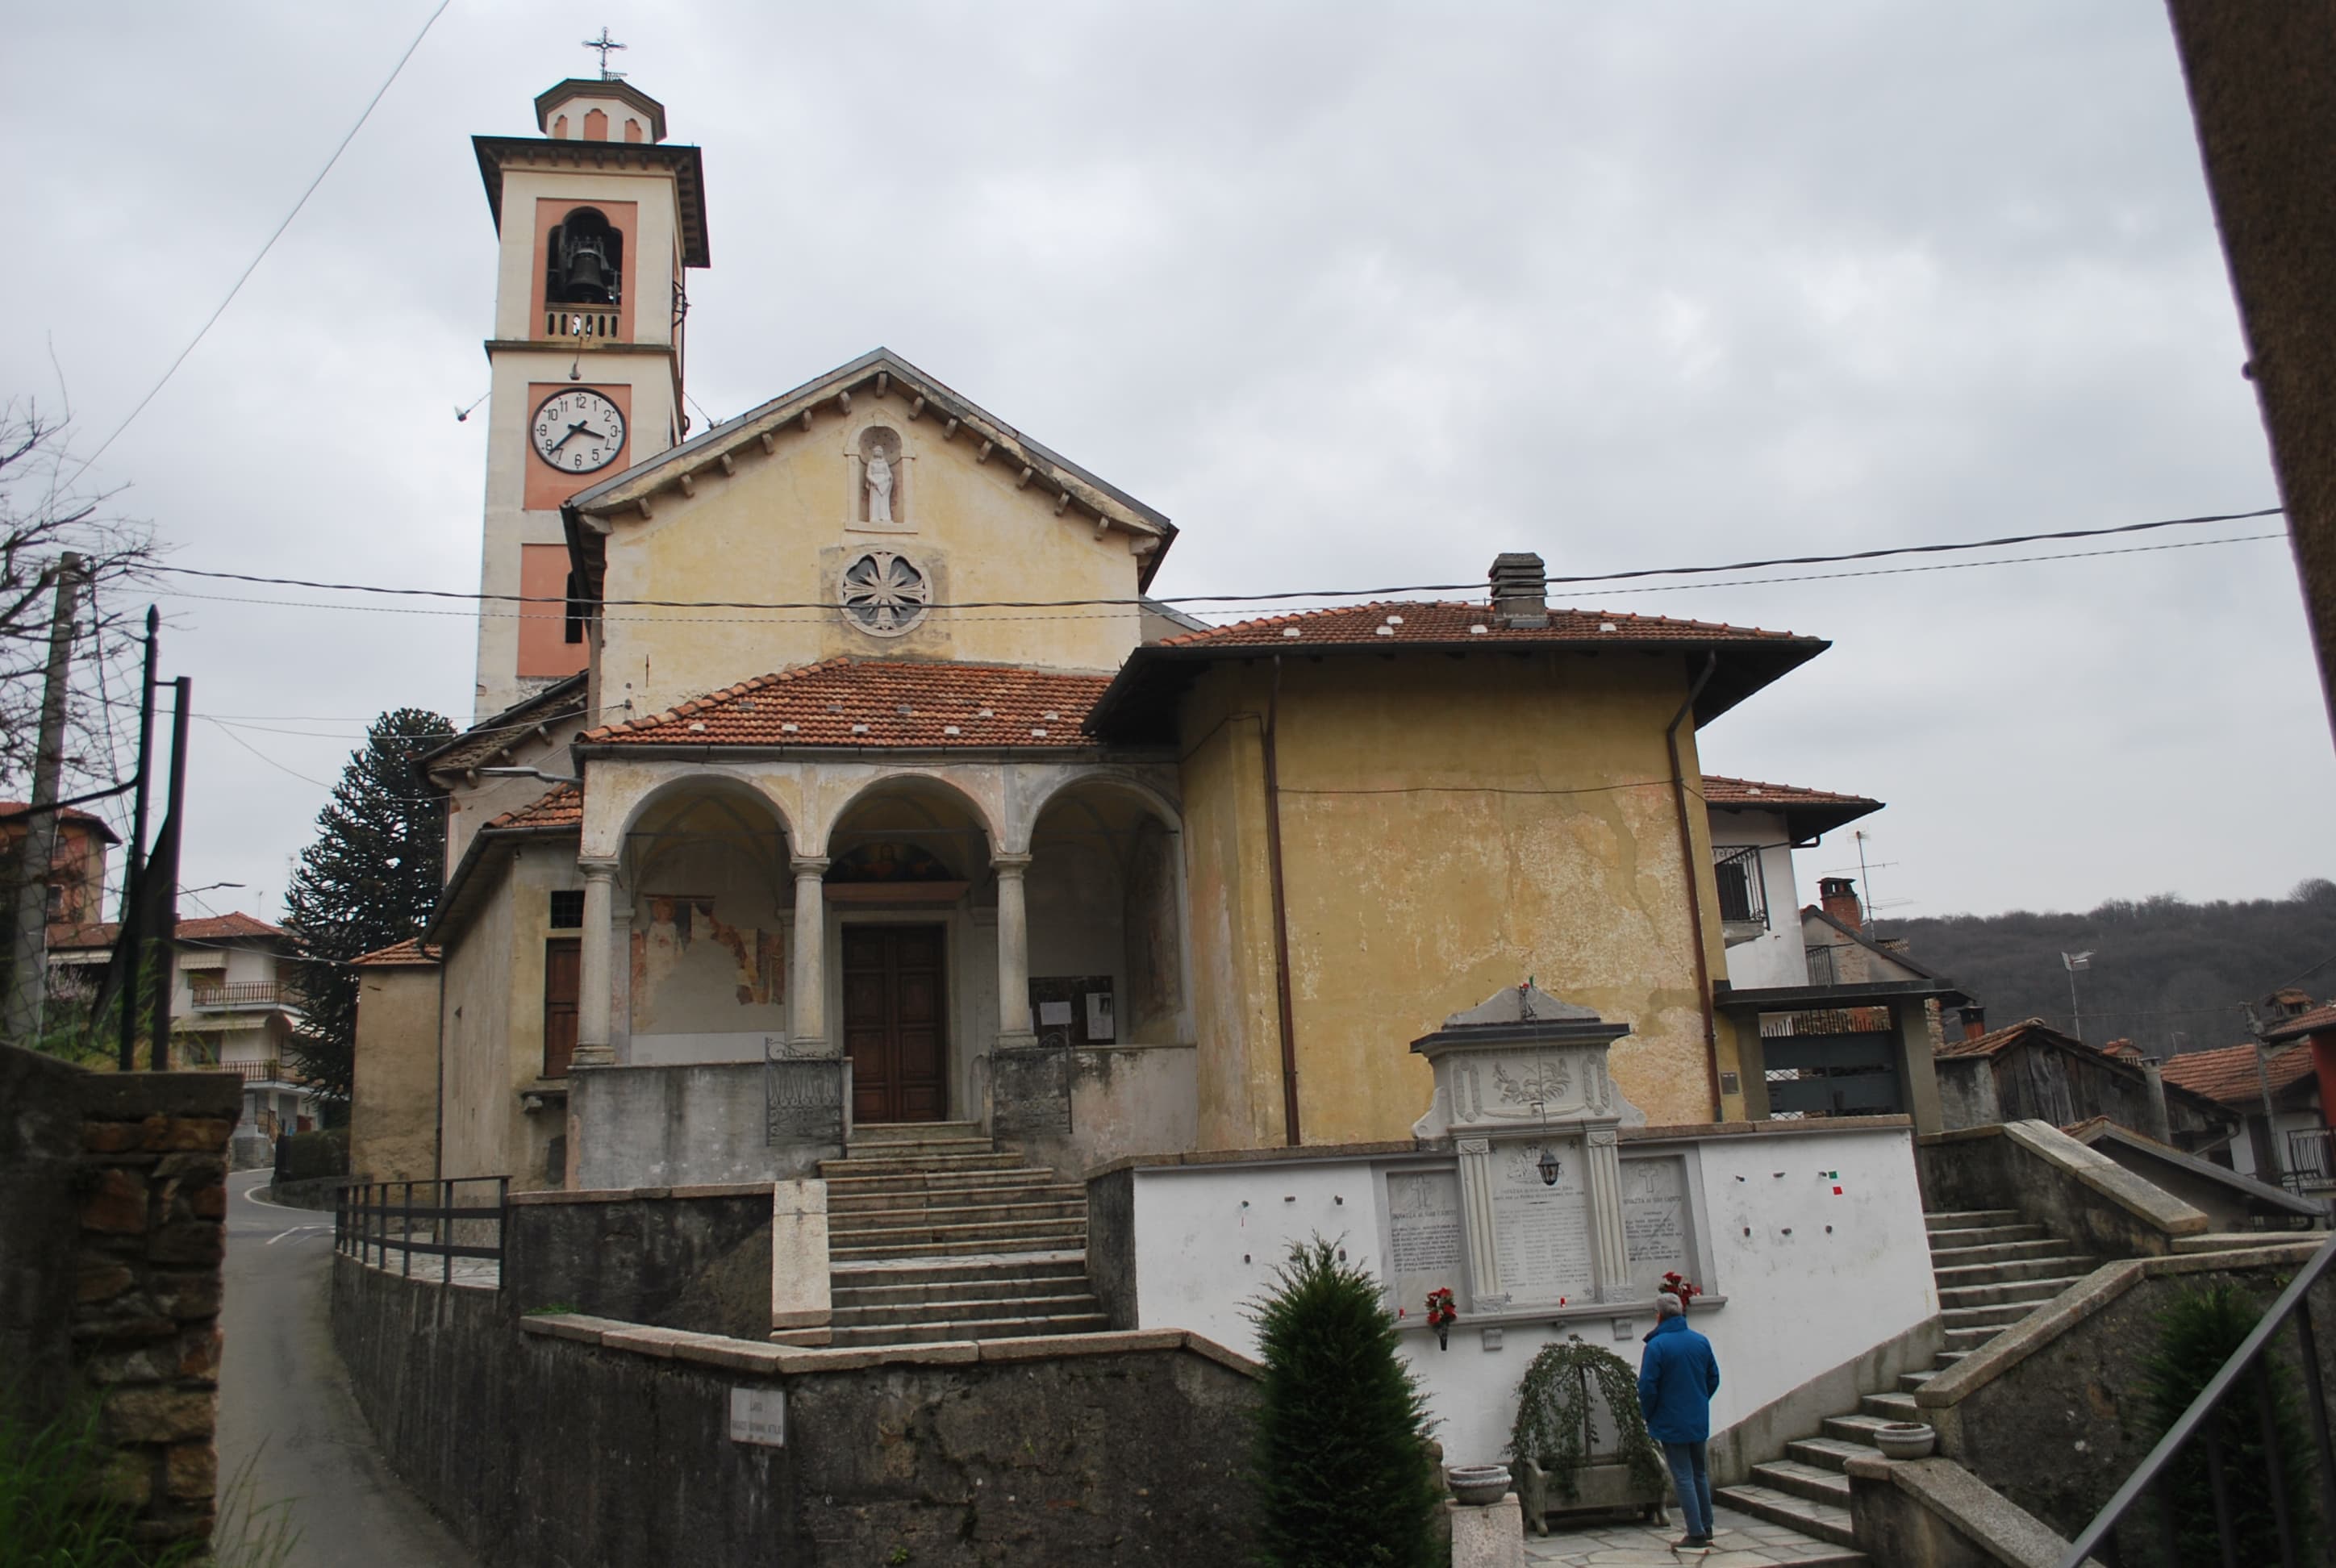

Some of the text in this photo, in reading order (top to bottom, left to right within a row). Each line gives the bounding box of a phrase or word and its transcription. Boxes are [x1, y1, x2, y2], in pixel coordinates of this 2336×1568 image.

[560, 401, 568, 412] 11
[575, 396, 586, 409] 12
[593, 400, 597, 411] 1
[548, 409, 558, 421] 10
[604, 410, 611, 422] 2
[540, 424, 547, 436] 9
[611, 425, 617, 437] 3
[546, 439, 553, 451] 8
[555, 448, 563, 461] 7
[575, 454, 582, 466] 6
[592, 449, 599, 461] 5
